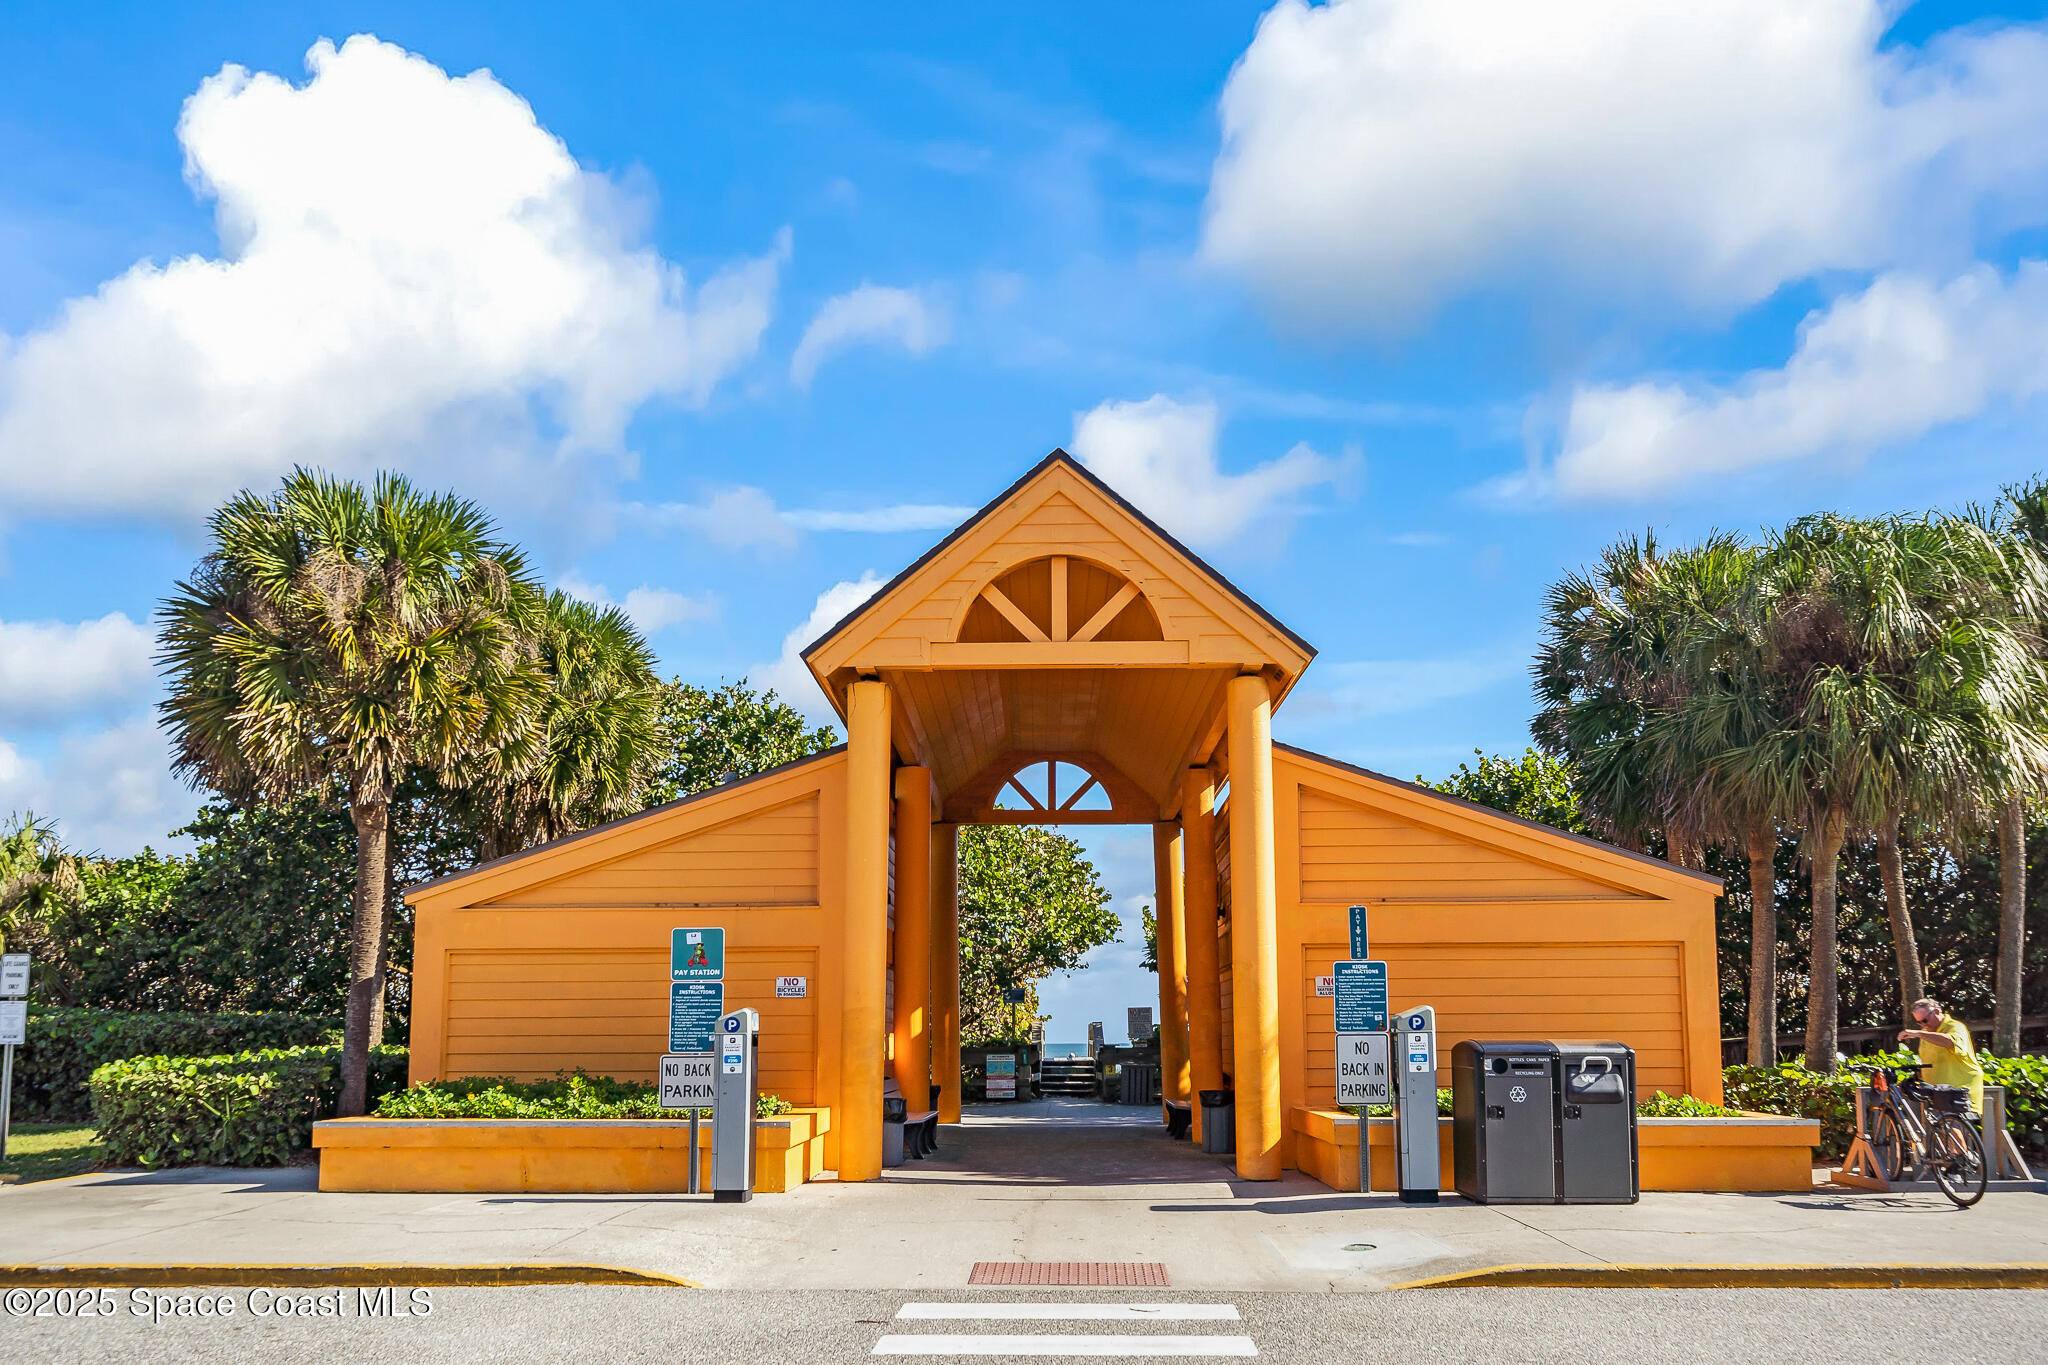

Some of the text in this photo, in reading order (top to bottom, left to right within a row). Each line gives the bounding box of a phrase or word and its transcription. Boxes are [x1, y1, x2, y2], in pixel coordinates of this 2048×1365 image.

[728, 1020, 737, 1030] P
[1412, 1018, 1421, 1028] P
[1355, 1042, 1369, 1054] NO
[665, 1064, 711, 1076] NO BACK
[1342, 1063, 1384, 1076] BACK IN
[664, 1085, 714, 1097] PARKIN
[1341, 1084, 1386, 1096] PARKING
